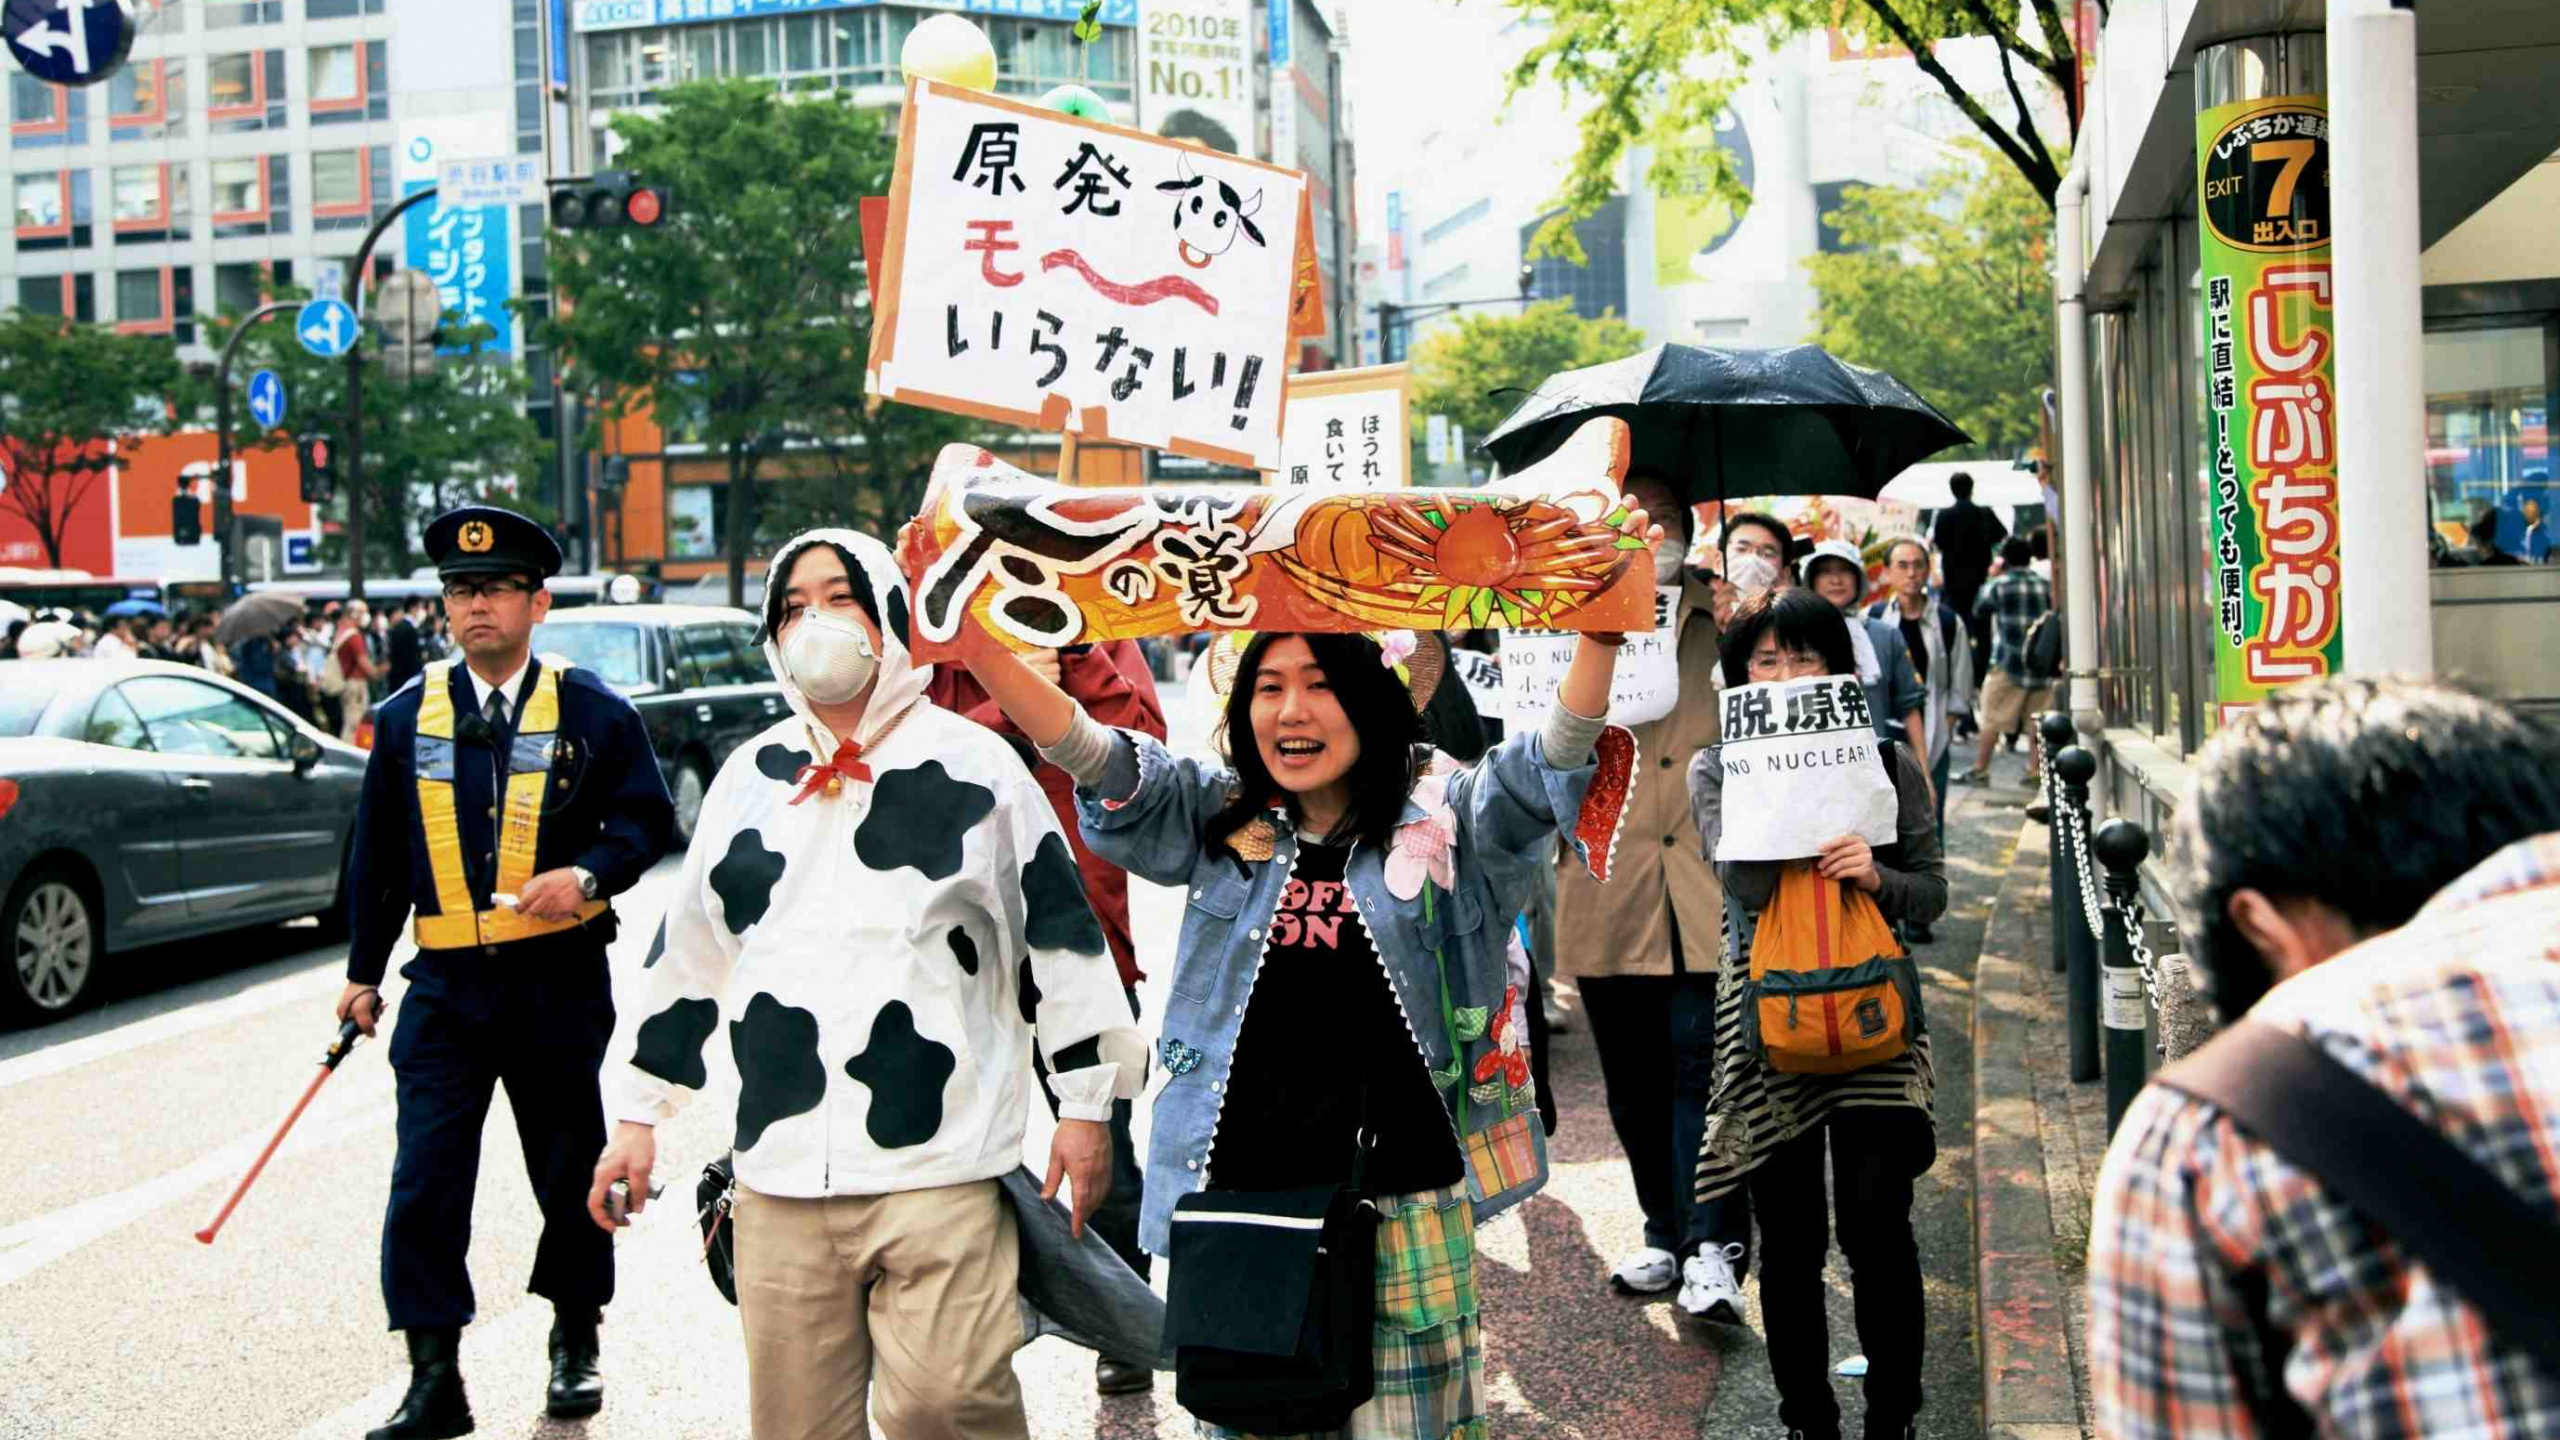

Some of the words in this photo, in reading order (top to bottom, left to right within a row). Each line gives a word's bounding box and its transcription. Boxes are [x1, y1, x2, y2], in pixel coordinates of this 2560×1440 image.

[1149, 12, 1241, 39] 2010年
[953, 123, 1132, 216] 原発
[2207, 175, 2243, 200] EXIT
[2251, 139, 2316, 218] 7
[2253, 219, 2318, 244] 出入口
[1325, 418, 1345, 482] 食いて
[1361, 415, 1381, 486] ほうれ
[1290, 465, 1309, 485] 原
[2250, 270, 2333, 678] 「しぶちか」
[1509, 651, 1536, 665] NO
[1724, 681, 1871, 740] 脱原発
[1727, 759, 1750, 776] NO
